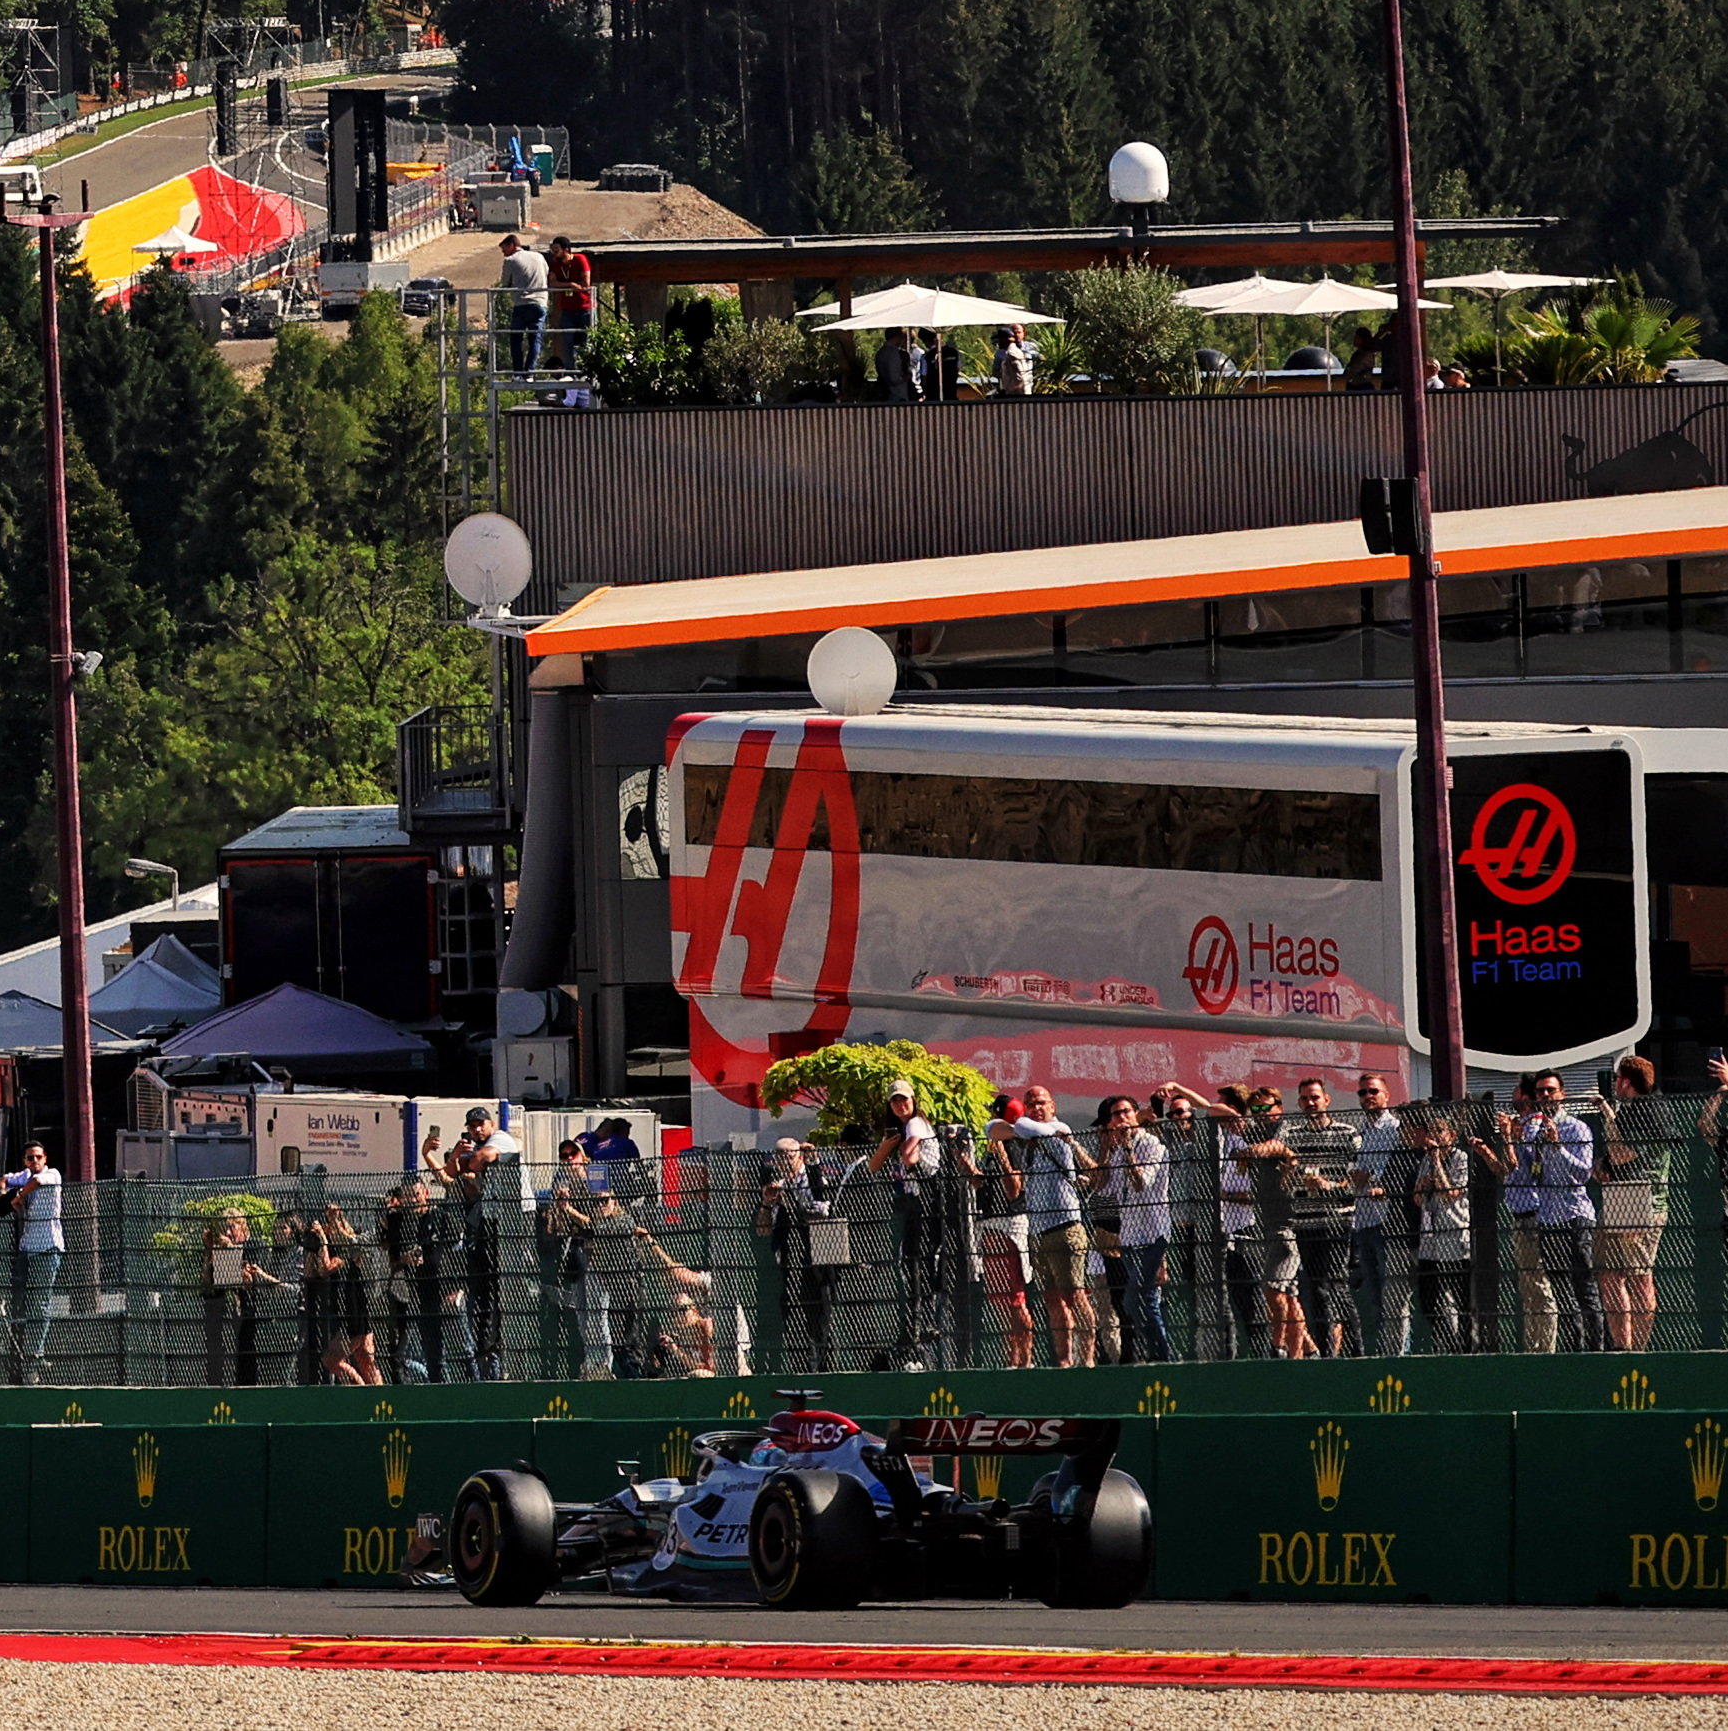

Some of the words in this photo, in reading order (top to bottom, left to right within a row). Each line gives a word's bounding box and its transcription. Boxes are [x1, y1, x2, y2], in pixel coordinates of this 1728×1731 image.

[1248, 922, 1341, 978] Haas
[1469, 919, 1582, 957] Haas
[1472, 961, 1500, 984] F1
[1508, 959, 1582, 982] Team
[1250, 979, 1274, 1011] F1
[1279, 980, 1341, 1016] Team
[308, 1113, 324, 1129] Ian
[327, 1114, 360, 1131] Webb
[797, 1423, 848, 1445] INEOS
[923, 1419, 1065, 1448] INEOS
[416, 1517, 441, 1539] IWC
[693, 1522, 750, 1544] PETR
[99, 1526, 191, 1572] ROLEX
[344, 1526, 416, 1574] ROL
[1259, 1531, 1397, 1586] ROLEX
[1629, 1533, 1728, 1590] ROL
